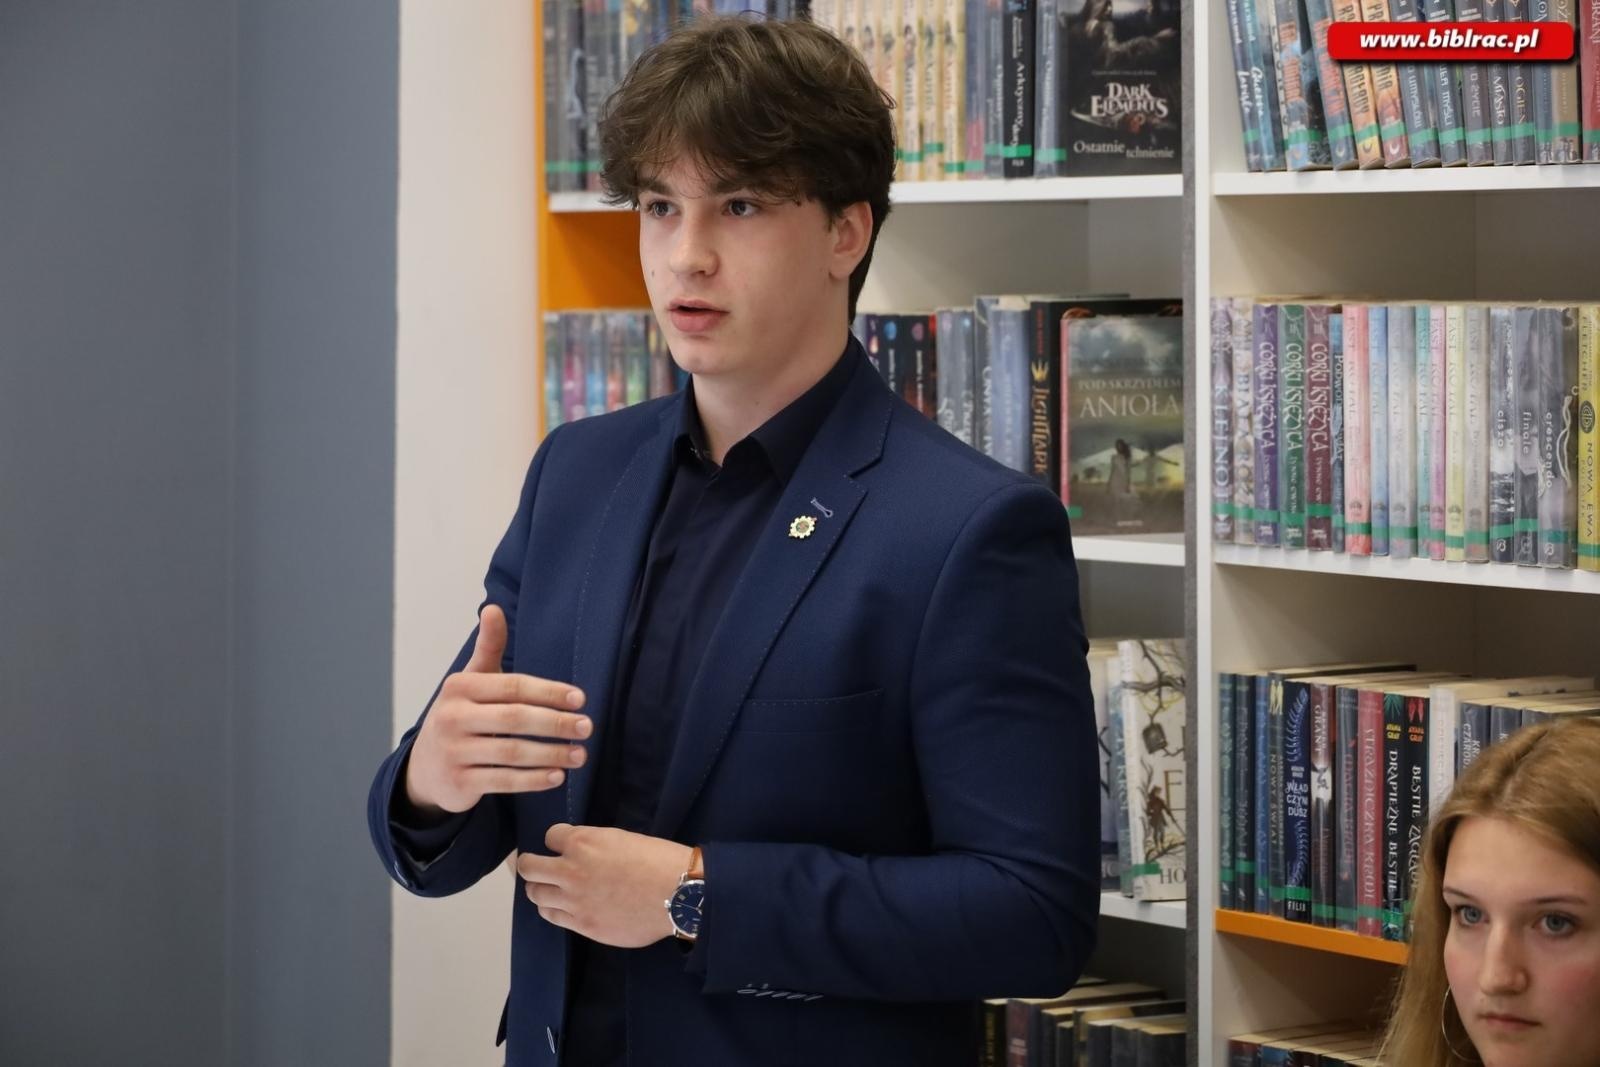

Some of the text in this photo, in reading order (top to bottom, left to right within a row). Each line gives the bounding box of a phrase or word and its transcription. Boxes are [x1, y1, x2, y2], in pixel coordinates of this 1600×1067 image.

[1091, 95, 1168, 118] ELEMENTS
[1105, 82, 1153, 100] DARK
[1073, 139, 1125, 153] Ostatnie
[1255, 342, 1276, 380] CÓRKI
[1281, 342, 1303, 382] CÓRKI
[1308, 343, 1330, 382] CÓRKI
[1080, 393, 1180, 418] ANIOŁA
[1545, 412, 1555, 489] crescendo
[1313, 704, 1323, 755] GRANT
[1462, 722, 1472, 767] CZAROD
[1411, 765, 1422, 817] BESTIE
[1386, 749, 1400, 892] DRAPIEŻNE BESTIE
